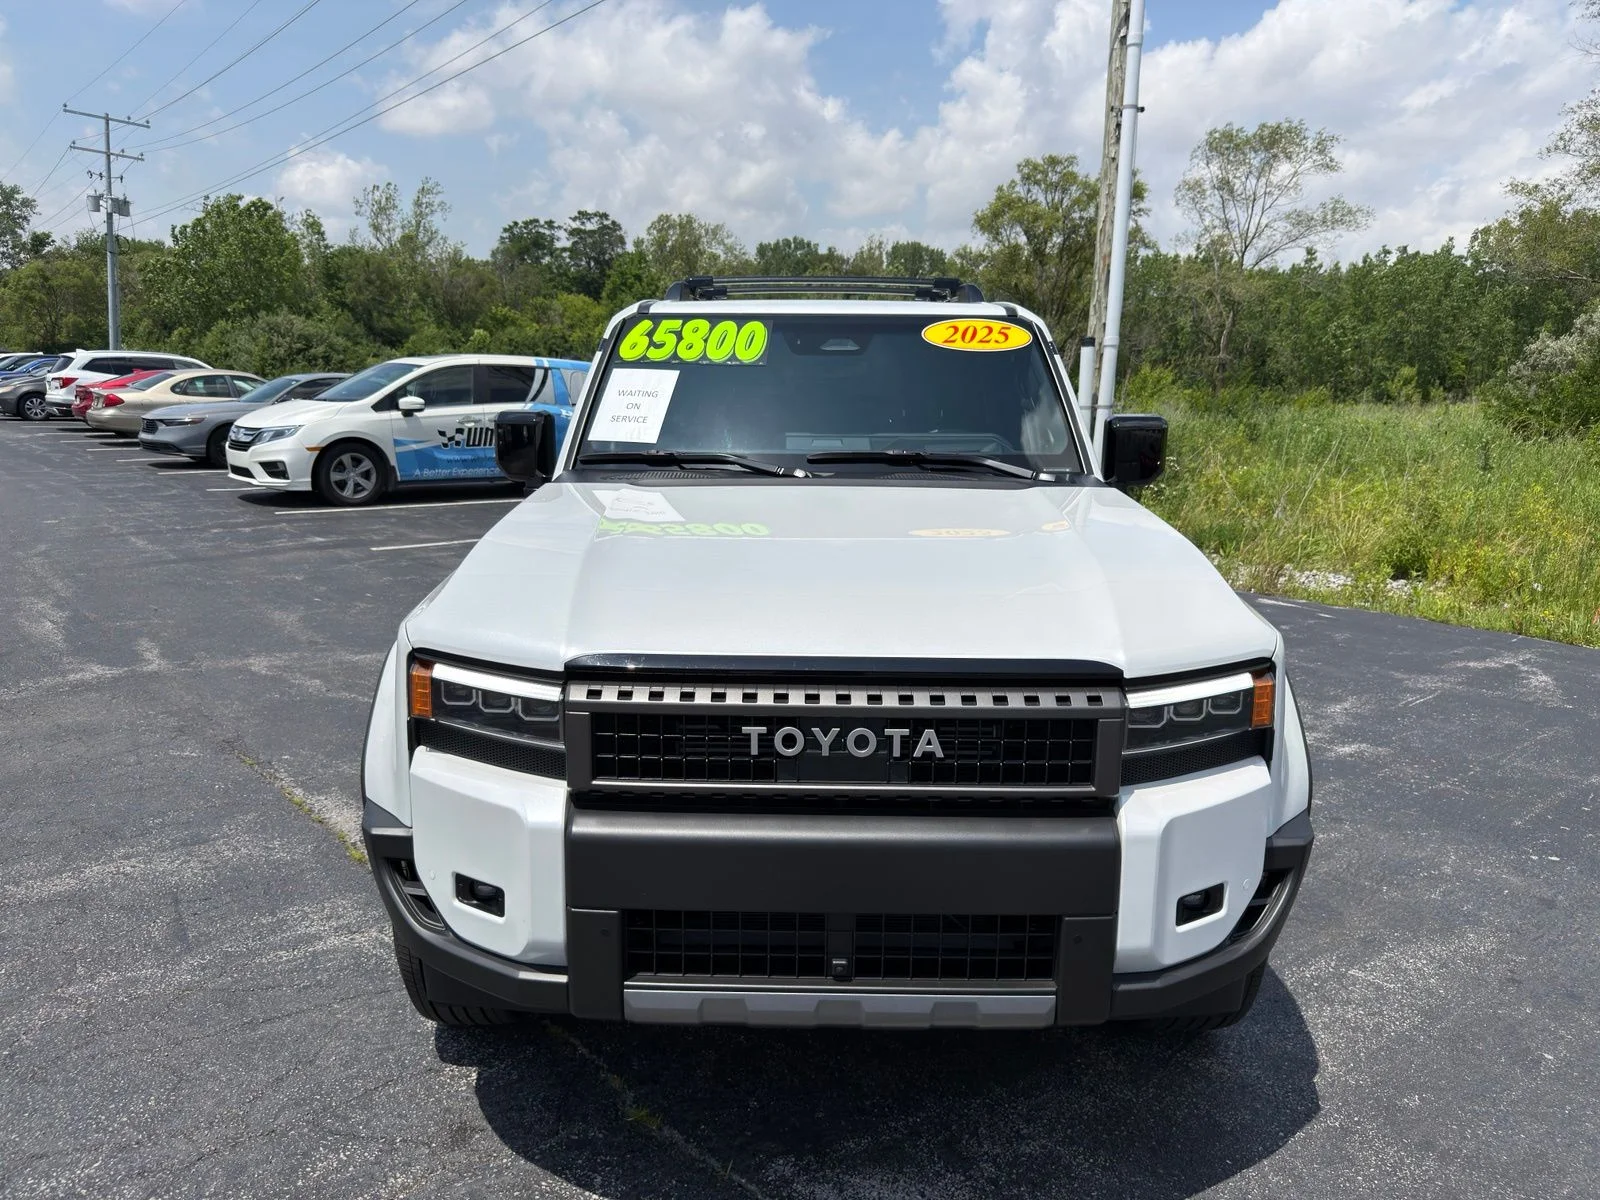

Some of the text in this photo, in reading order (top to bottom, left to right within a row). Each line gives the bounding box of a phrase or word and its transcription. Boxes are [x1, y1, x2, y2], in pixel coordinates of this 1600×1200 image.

[942, 325, 1011, 344] 2025
[619, 319, 768, 363] 65800
[618, 389, 659, 398] WAITING
[626, 402, 641, 410] ON
[610, 415, 648, 424] SERVICE
[414, 466, 500, 478] A Better Experience
[741, 726, 944, 758] TOYOTA
